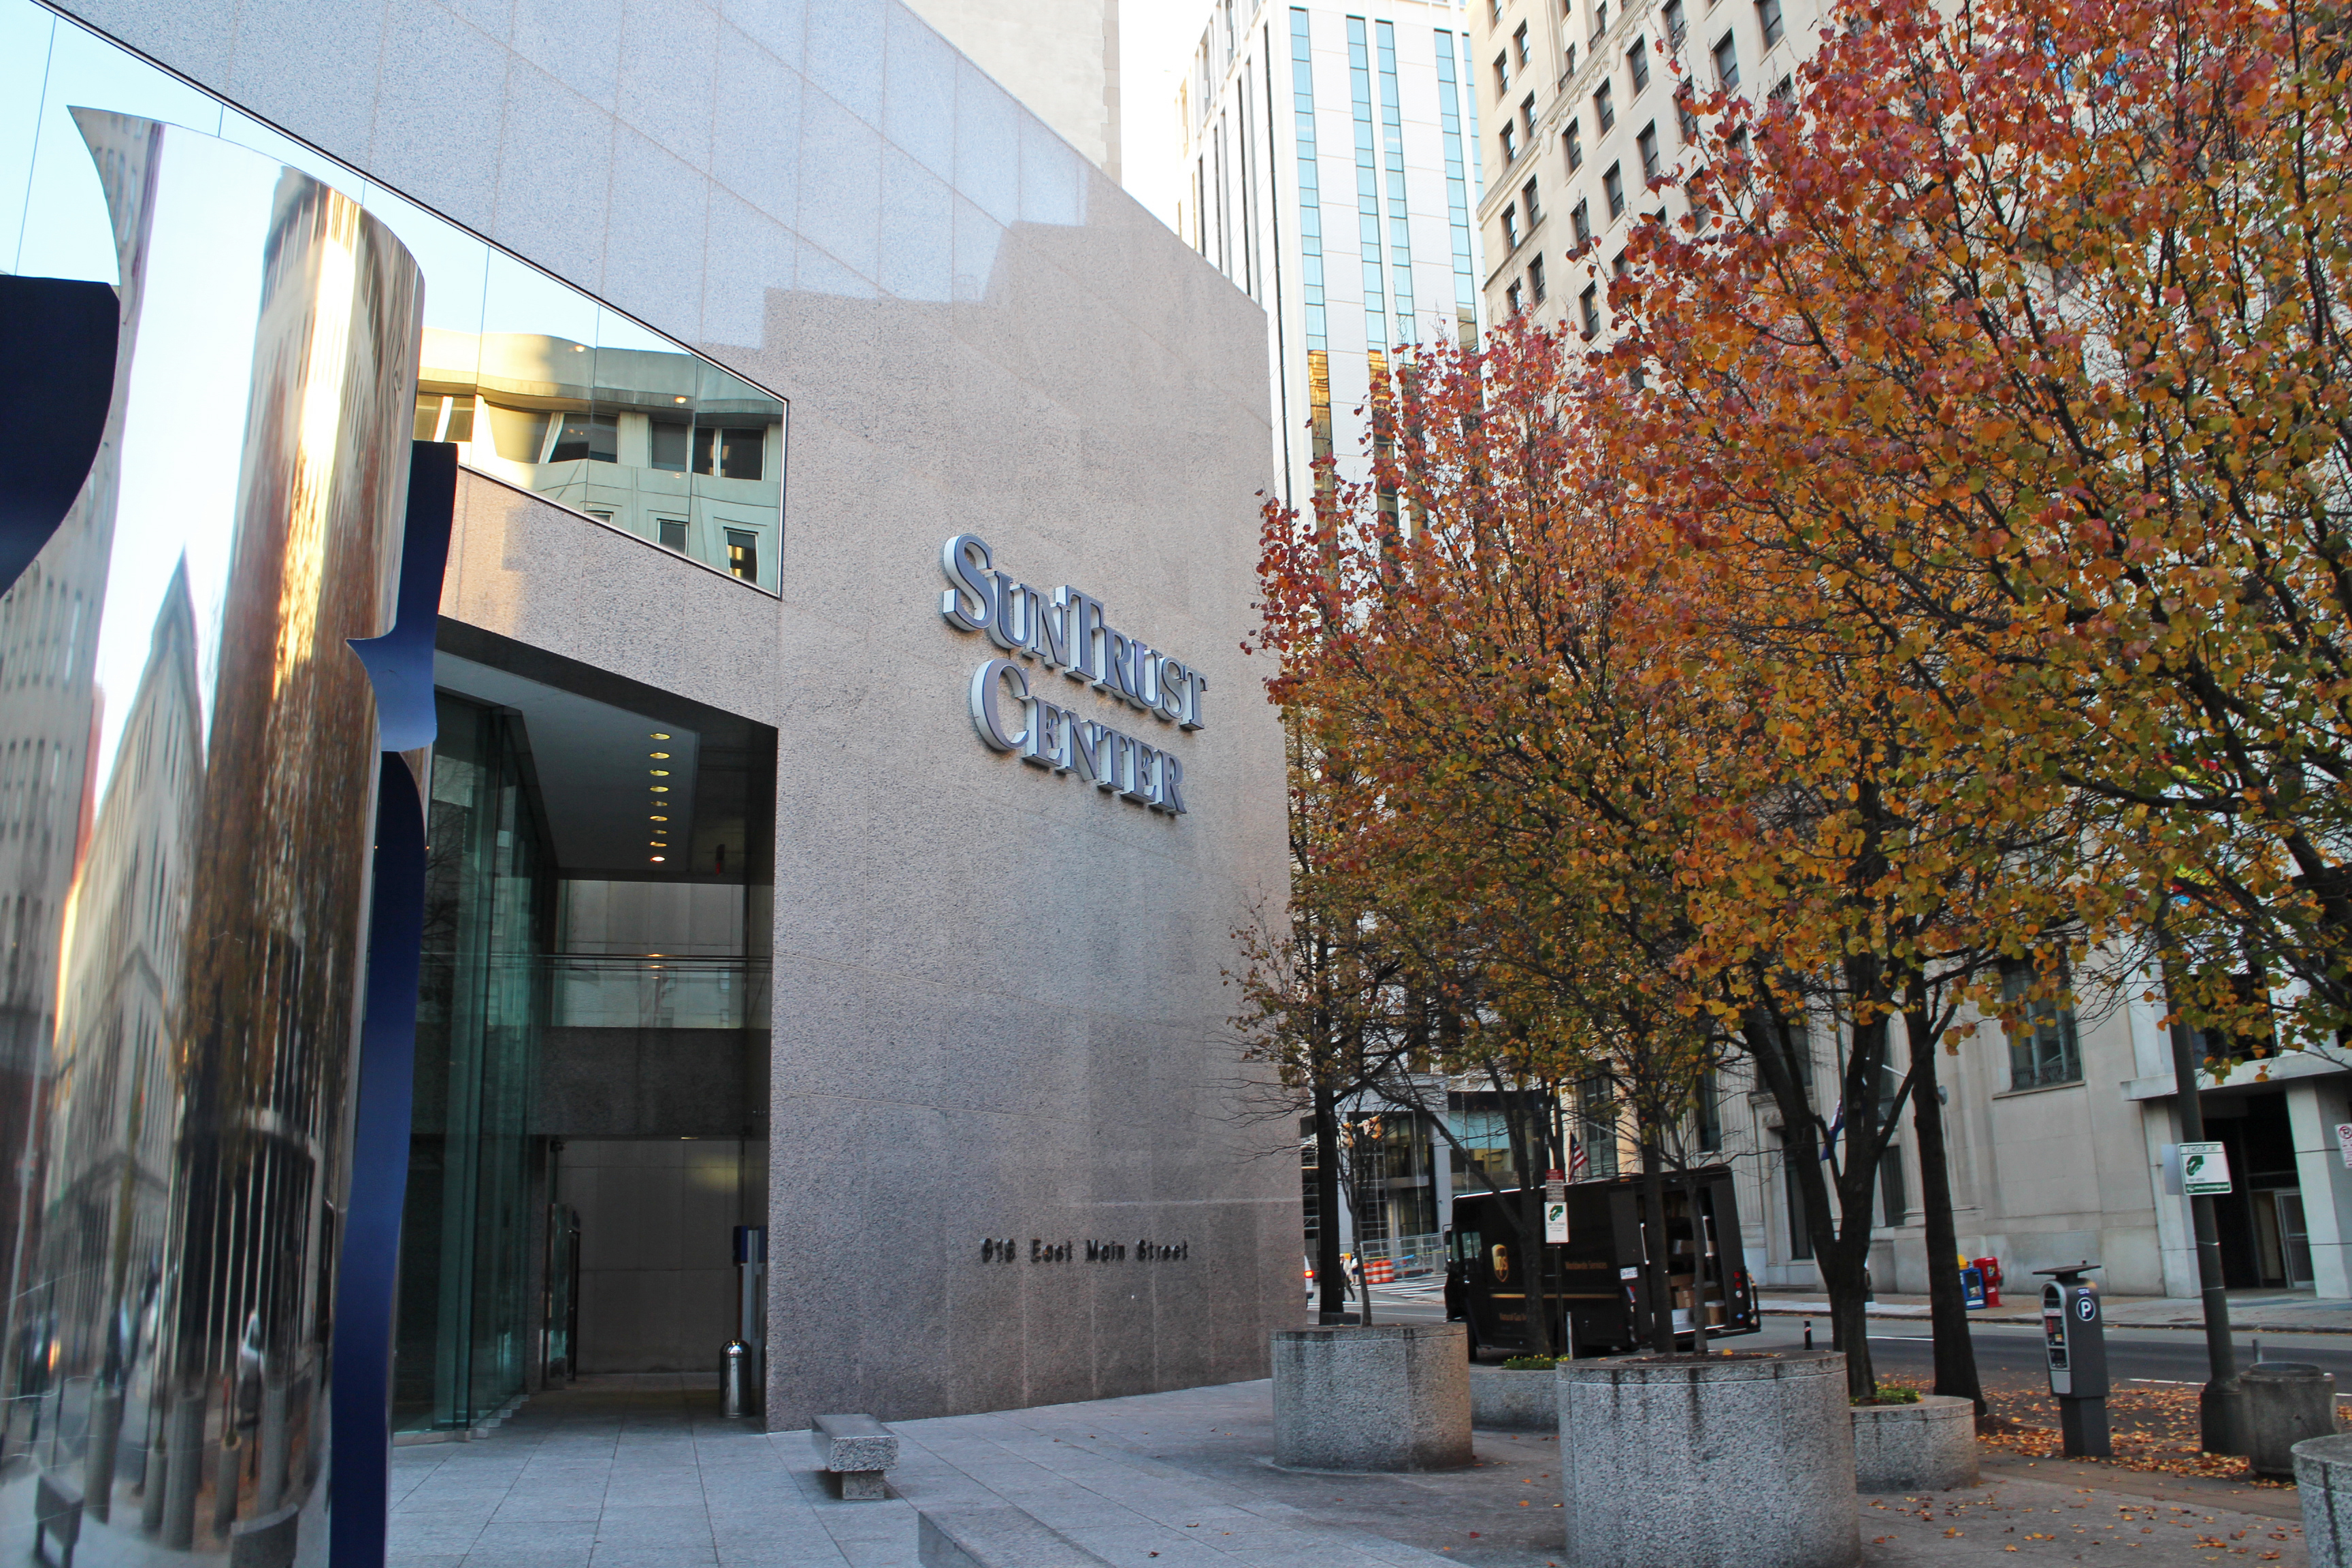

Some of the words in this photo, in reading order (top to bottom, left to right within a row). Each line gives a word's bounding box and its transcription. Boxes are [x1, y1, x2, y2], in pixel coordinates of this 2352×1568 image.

[971, 658, 1187, 815] CENTER
[1030, 1238, 1073, 1262] East
[1085, 1239, 1125, 1261] Main
[1136, 1239, 1188, 1262] Street
[1494, 1256, 1508, 1277] ups
